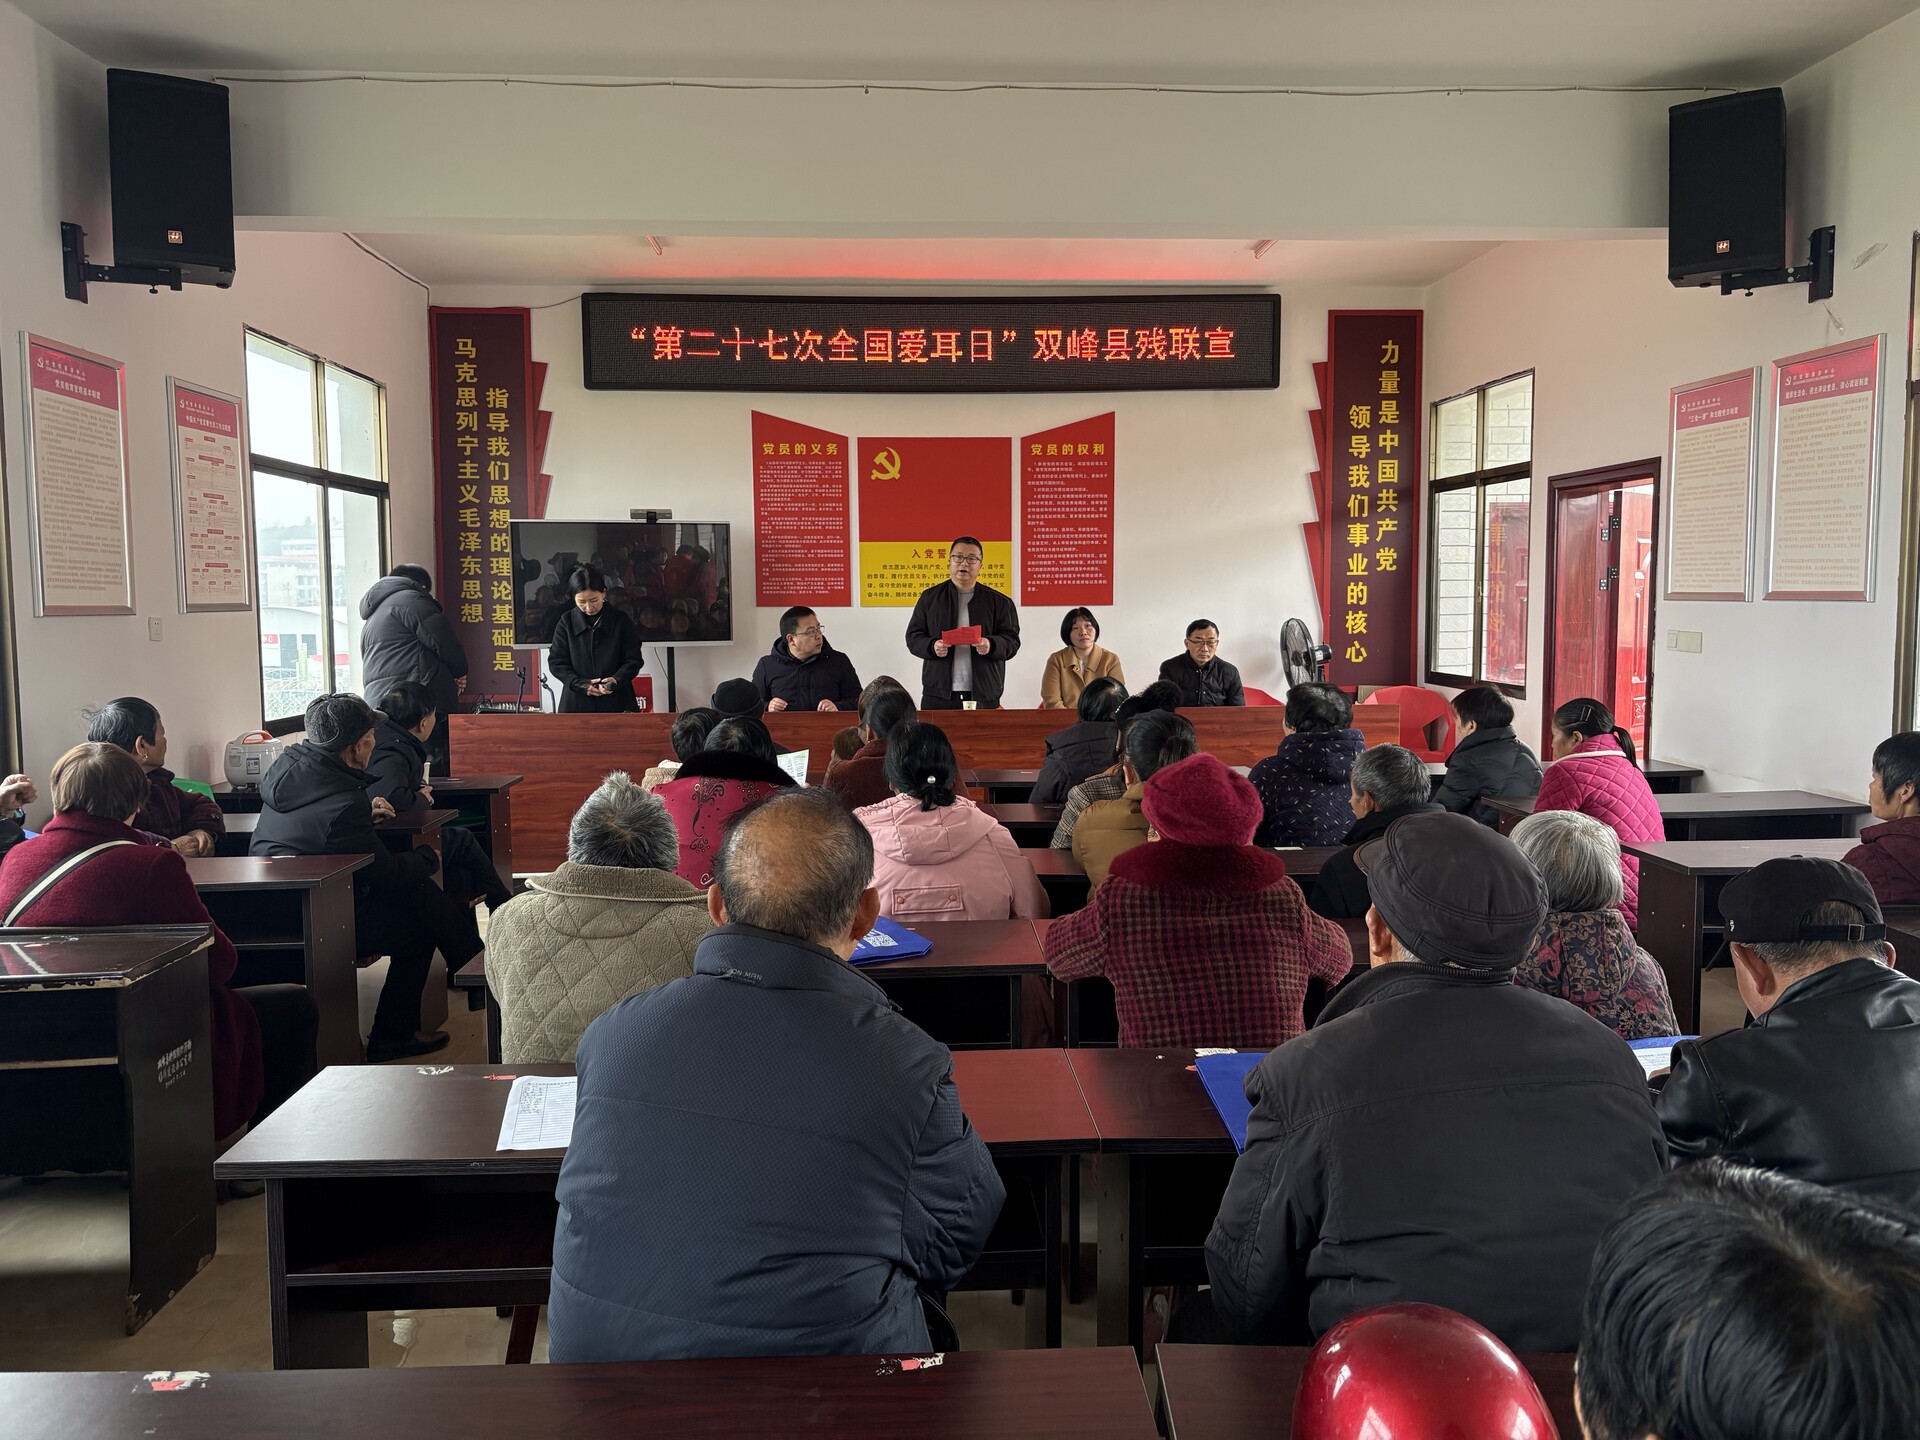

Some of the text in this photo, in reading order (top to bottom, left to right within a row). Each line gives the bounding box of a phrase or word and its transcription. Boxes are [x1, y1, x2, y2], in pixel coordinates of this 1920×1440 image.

[455, 338, 484, 623] 马克思列宁主义毛泽东思想
[485, 387, 516, 672] 指导我们思想的理论基础是
[762, 442, 839, 456] 党员的义务
[1031, 442, 1105, 456] 党员的权利
[1345, 404, 1371, 664] 领导我们事业的核心
[1375, 339, 1400, 572] 力量是中国共产党
